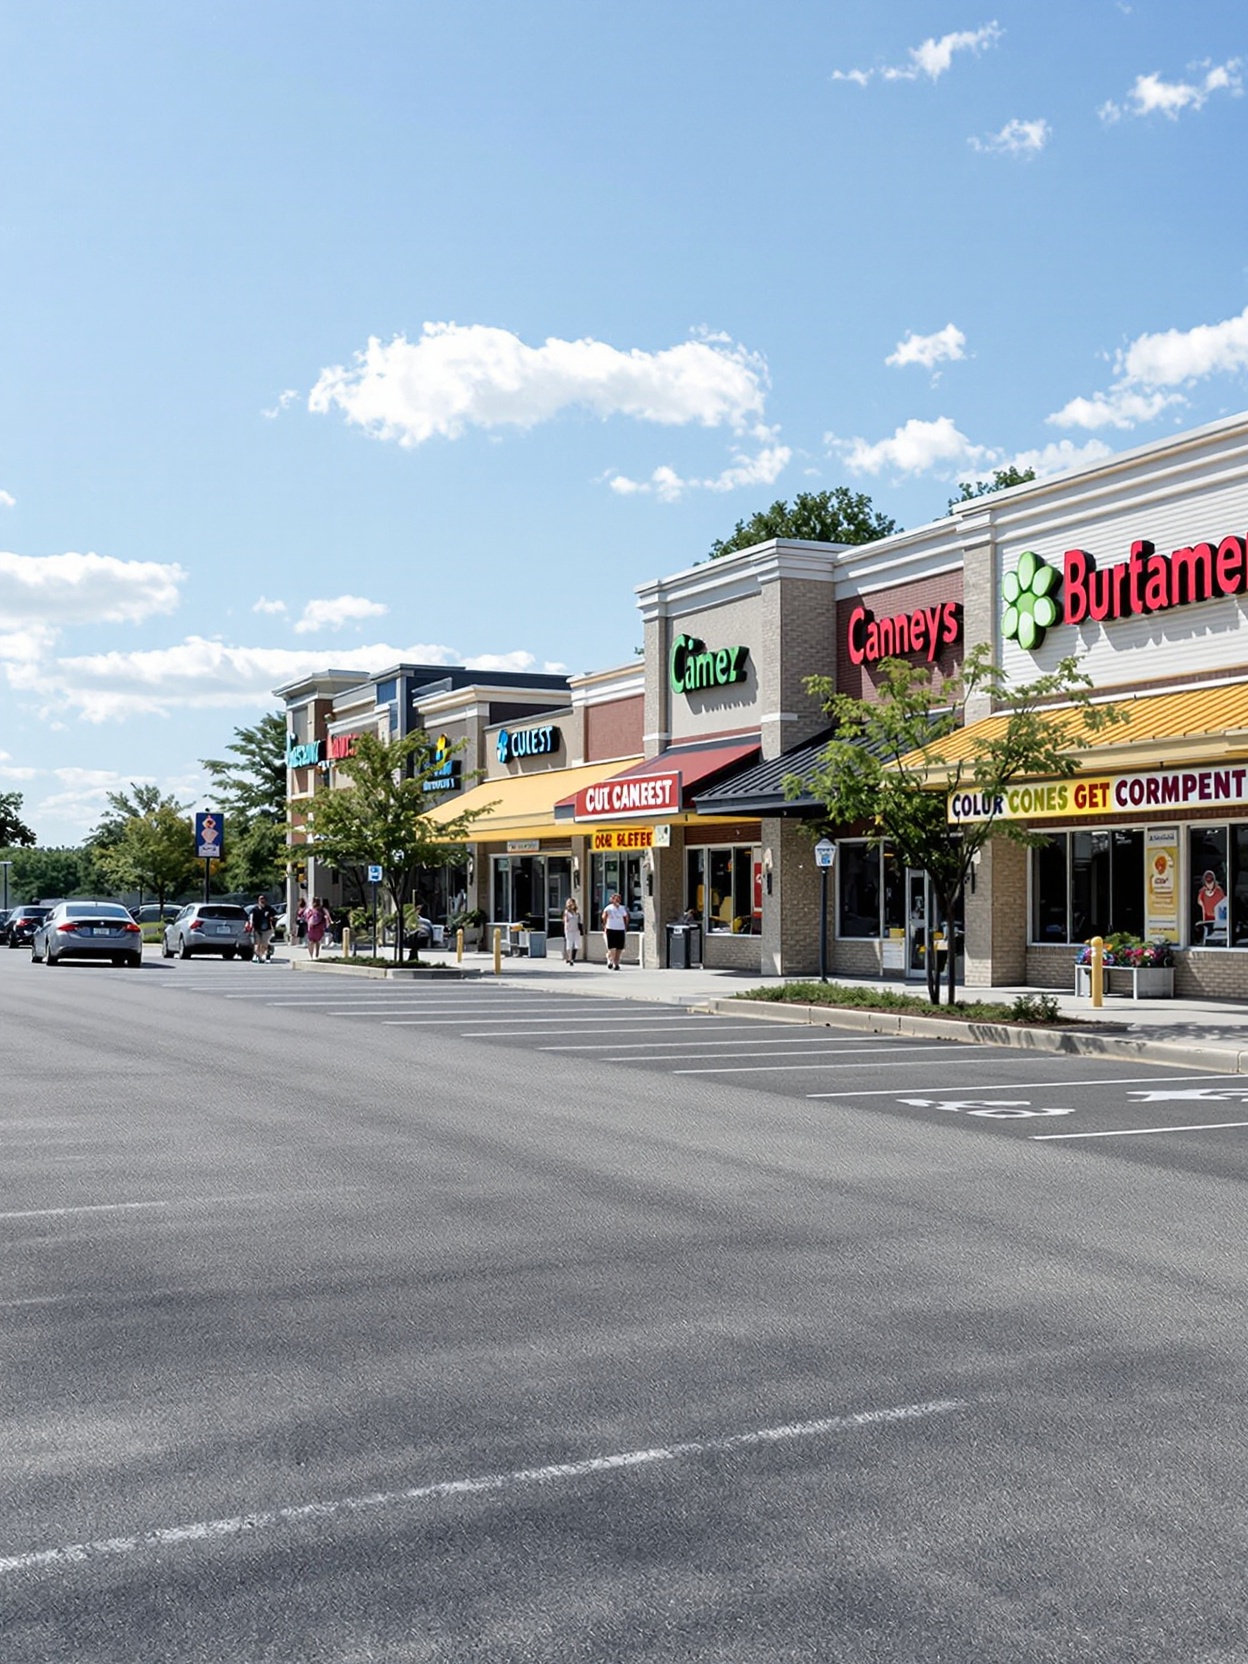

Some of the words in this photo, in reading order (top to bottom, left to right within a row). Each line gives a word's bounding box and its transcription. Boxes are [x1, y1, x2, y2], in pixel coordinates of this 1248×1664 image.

[848, 602, 958, 664] Canneys
[1008, 785, 1068, 814] CONES
[1074, 782, 1110, 809] GET
